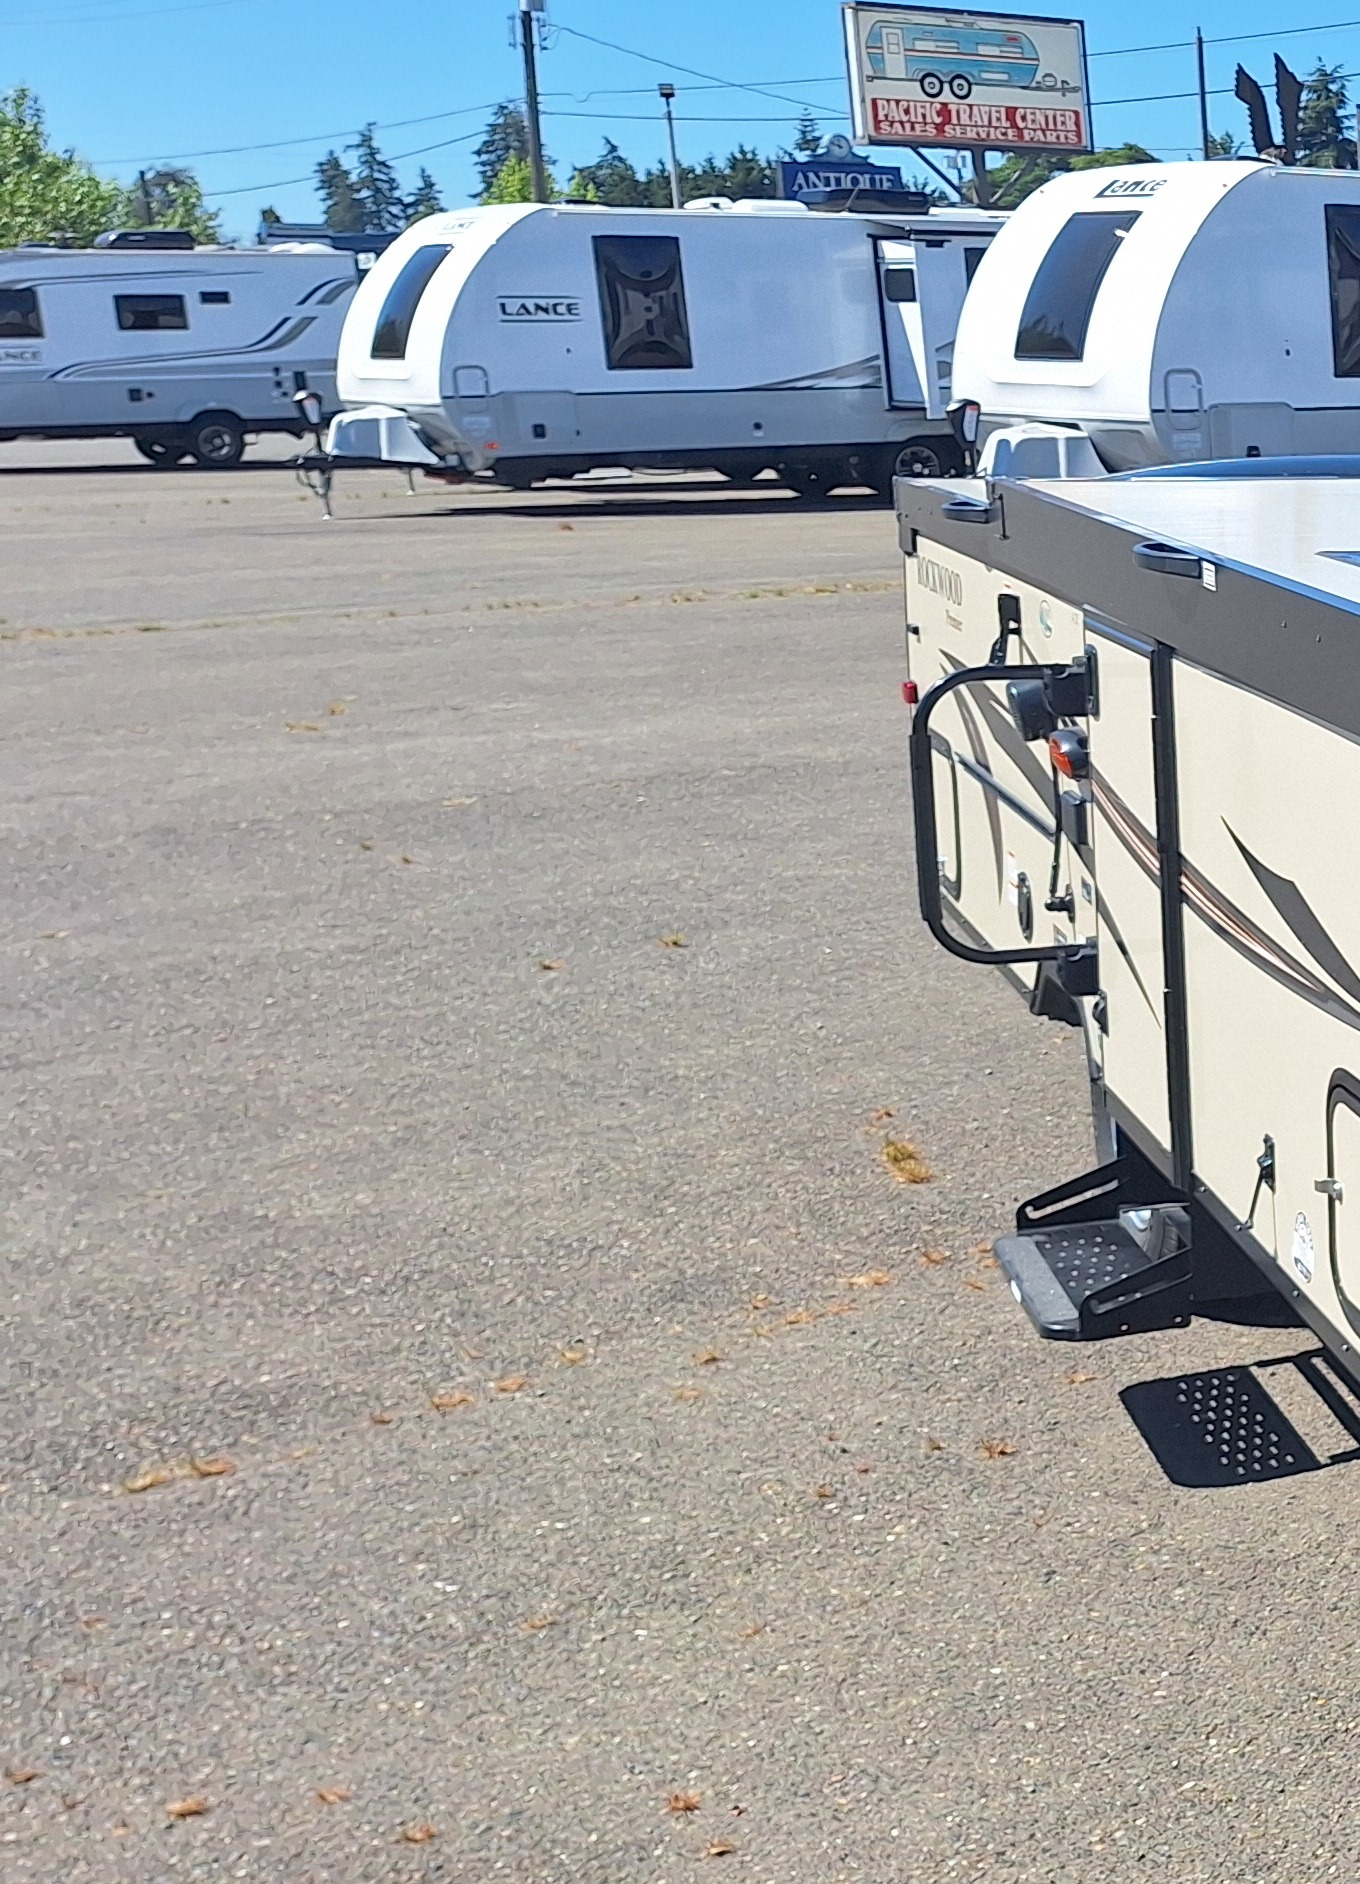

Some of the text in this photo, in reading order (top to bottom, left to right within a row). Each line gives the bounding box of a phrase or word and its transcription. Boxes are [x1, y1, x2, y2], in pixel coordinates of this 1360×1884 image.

[877, 99, 1077, 131] PACIFIC TRAVEL CENTER
[879, 121, 1078, 144] SALES SERVICE PARTS
[1093, 179, 1168, 198] Lance
[499, 302, 580, 316] LANCE
